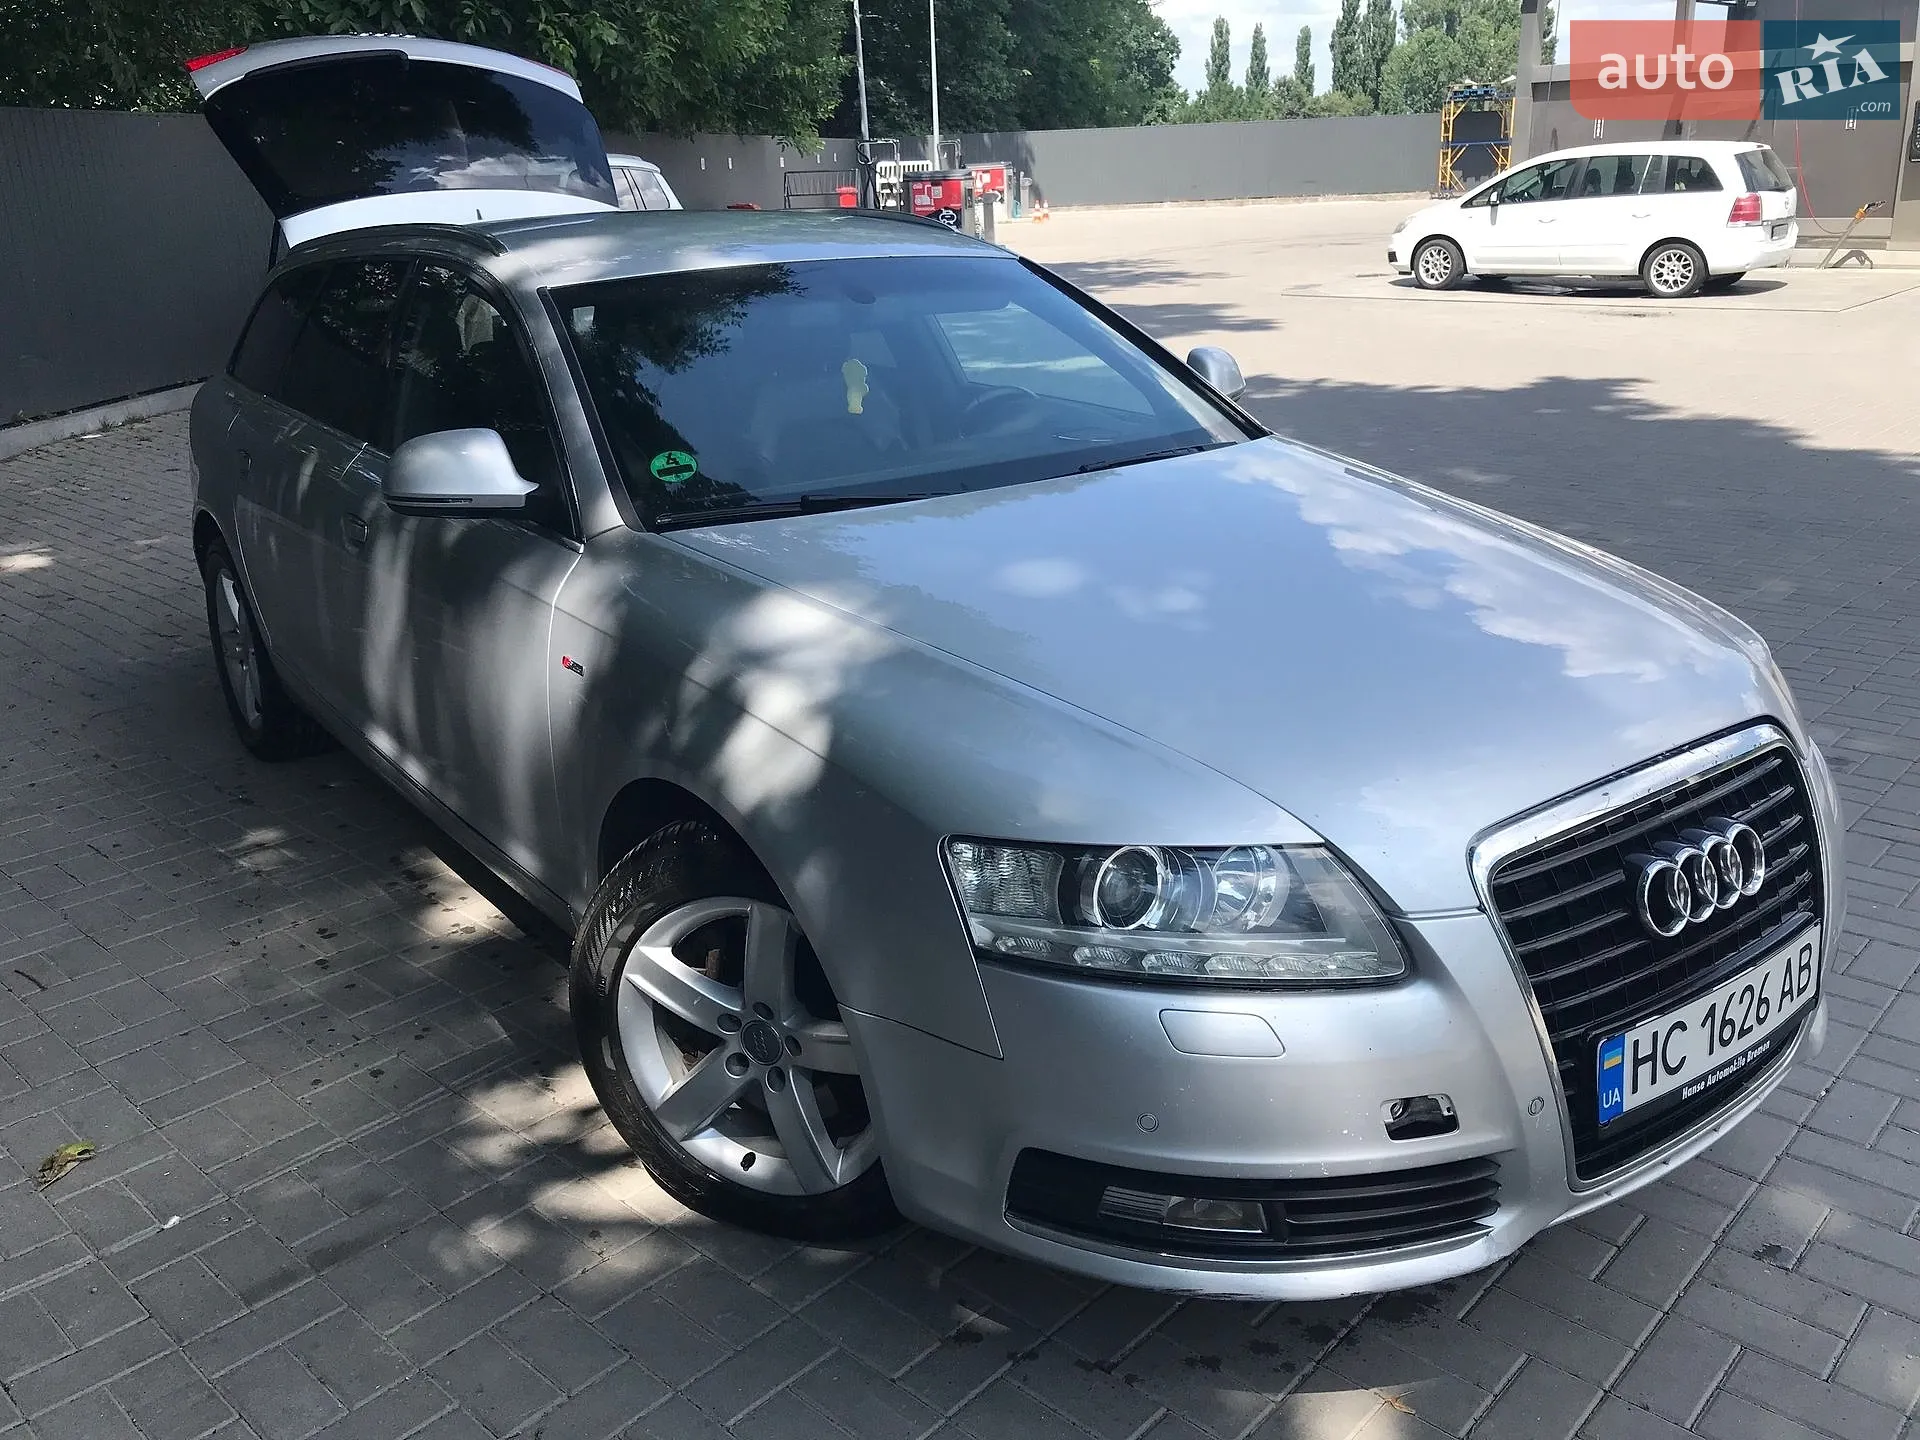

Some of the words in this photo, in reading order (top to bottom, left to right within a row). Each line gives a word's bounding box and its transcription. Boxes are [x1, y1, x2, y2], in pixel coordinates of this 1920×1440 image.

[1631, 1020, 1689, 1095] HC
[1701, 971, 1771, 1057] 1626
[1778, 942, 1813, 1014] AB
[1603, 1088, 1621, 1109] UA
[1682, 1081, 1705, 1100] Hanse
